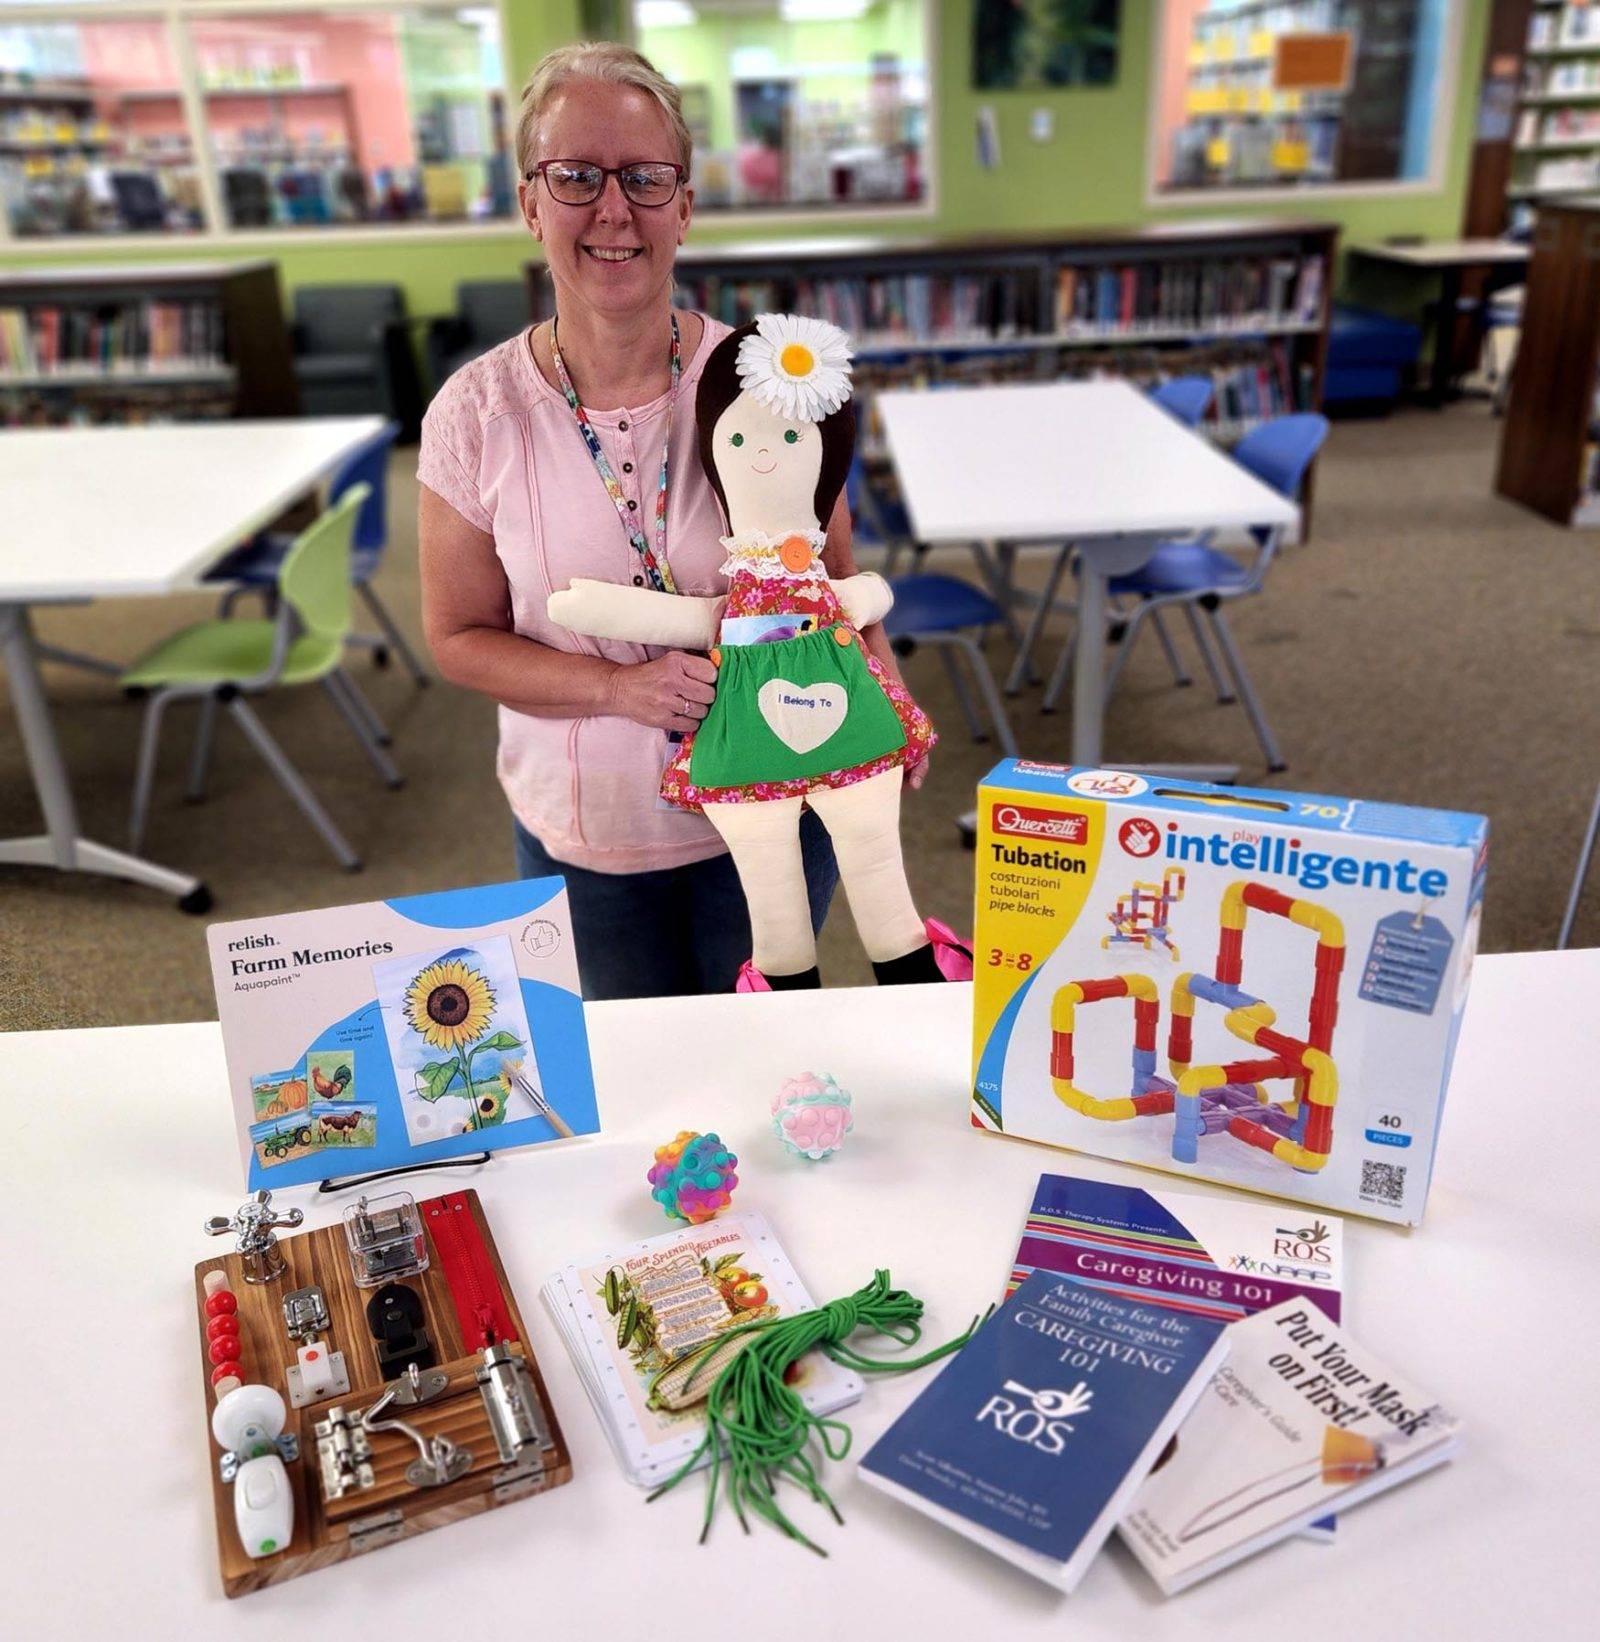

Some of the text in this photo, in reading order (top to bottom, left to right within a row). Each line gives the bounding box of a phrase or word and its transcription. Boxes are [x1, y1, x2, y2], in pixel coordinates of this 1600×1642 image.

[784, 695, 815, 708] Belong
[820, 698, 832, 707] To
[1232, 829, 1261, 845] play
[991, 843, 1086, 875] Tubation
[1166, 822, 1448, 898] intelligente
[990, 871, 1061, 890] costruzioni
[990, 885, 1040, 901] tubolari
[989, 899, 1056, 918] pipe blocks
[231, 941, 394, 976] Farm Memories
[1379, 1114, 1401, 1129] 40
[1065, 1210, 1095, 1222] Therapy
[1097, 1216, 1130, 1229] Systems
[1274, 1238, 1332, 1263] ROS
[1077, 1253, 1272, 1303] Caregiving 101
[1040, 1294, 1184, 1348] Family Caregiver
[1049, 1284, 1191, 1335] Activities for the
[1014, 1311, 1176, 1375] CAREGIVING
[1058, 1348, 1100, 1374] 101
[1275, 1310, 1432, 1437] Put Your Mask
[1268, 1353, 1371, 1428] on First!
[975, 1395, 1075, 1456] ROS
